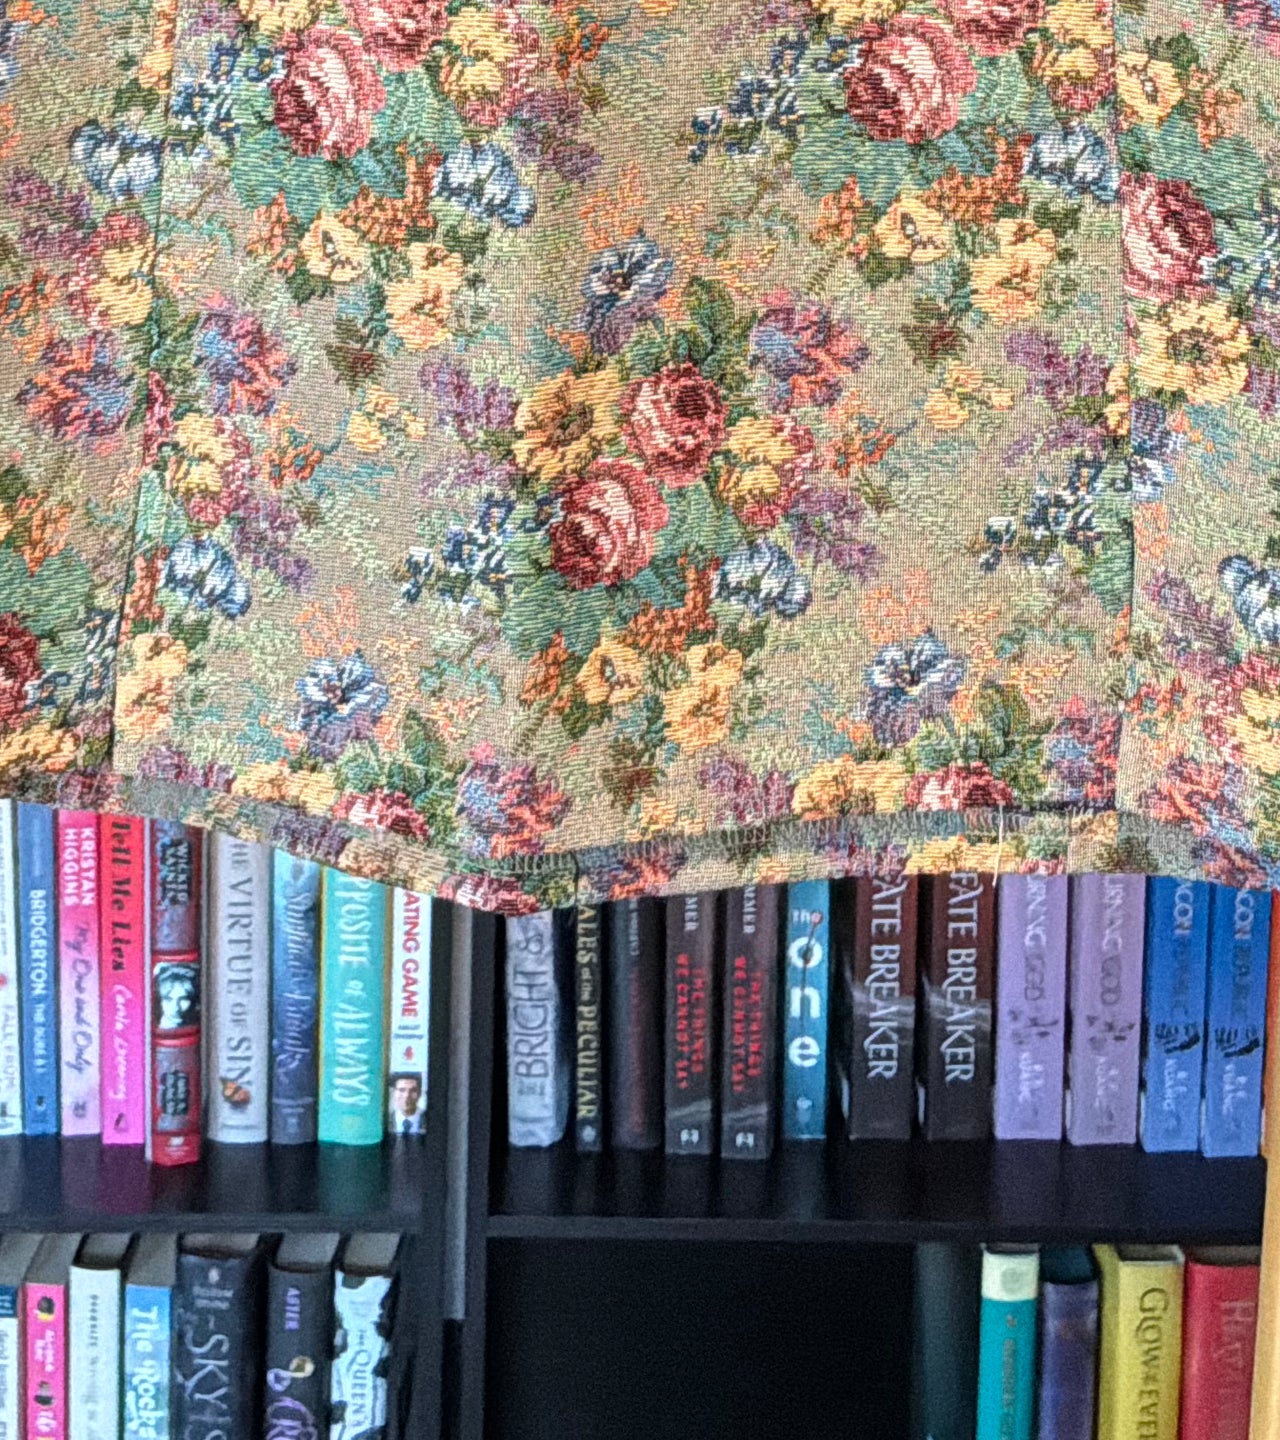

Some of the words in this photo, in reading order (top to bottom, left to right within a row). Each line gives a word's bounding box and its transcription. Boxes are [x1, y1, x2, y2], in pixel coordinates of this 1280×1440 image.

[64, 828, 79, 907] HIGGINS
[80, 827, 97, 906] KRISTAN
[112, 876, 132, 912] Me
[29, 889, 48, 996] BRIDGERTON
[226, 876, 253, 996] VIRTUE
[402, 958, 420, 1017] GAME
[333, 1001, 372, 1107] ALWAYS
[514, 969, 550, 1079] BRIGHT
[788, 936, 822, 1067] one
[864, 944, 901, 1079] BREAKER
[945, 947, 978, 1084] BREAKER
[576, 1005, 598, 1120] PECULIAR
[131, 1306, 159, 1353] The
